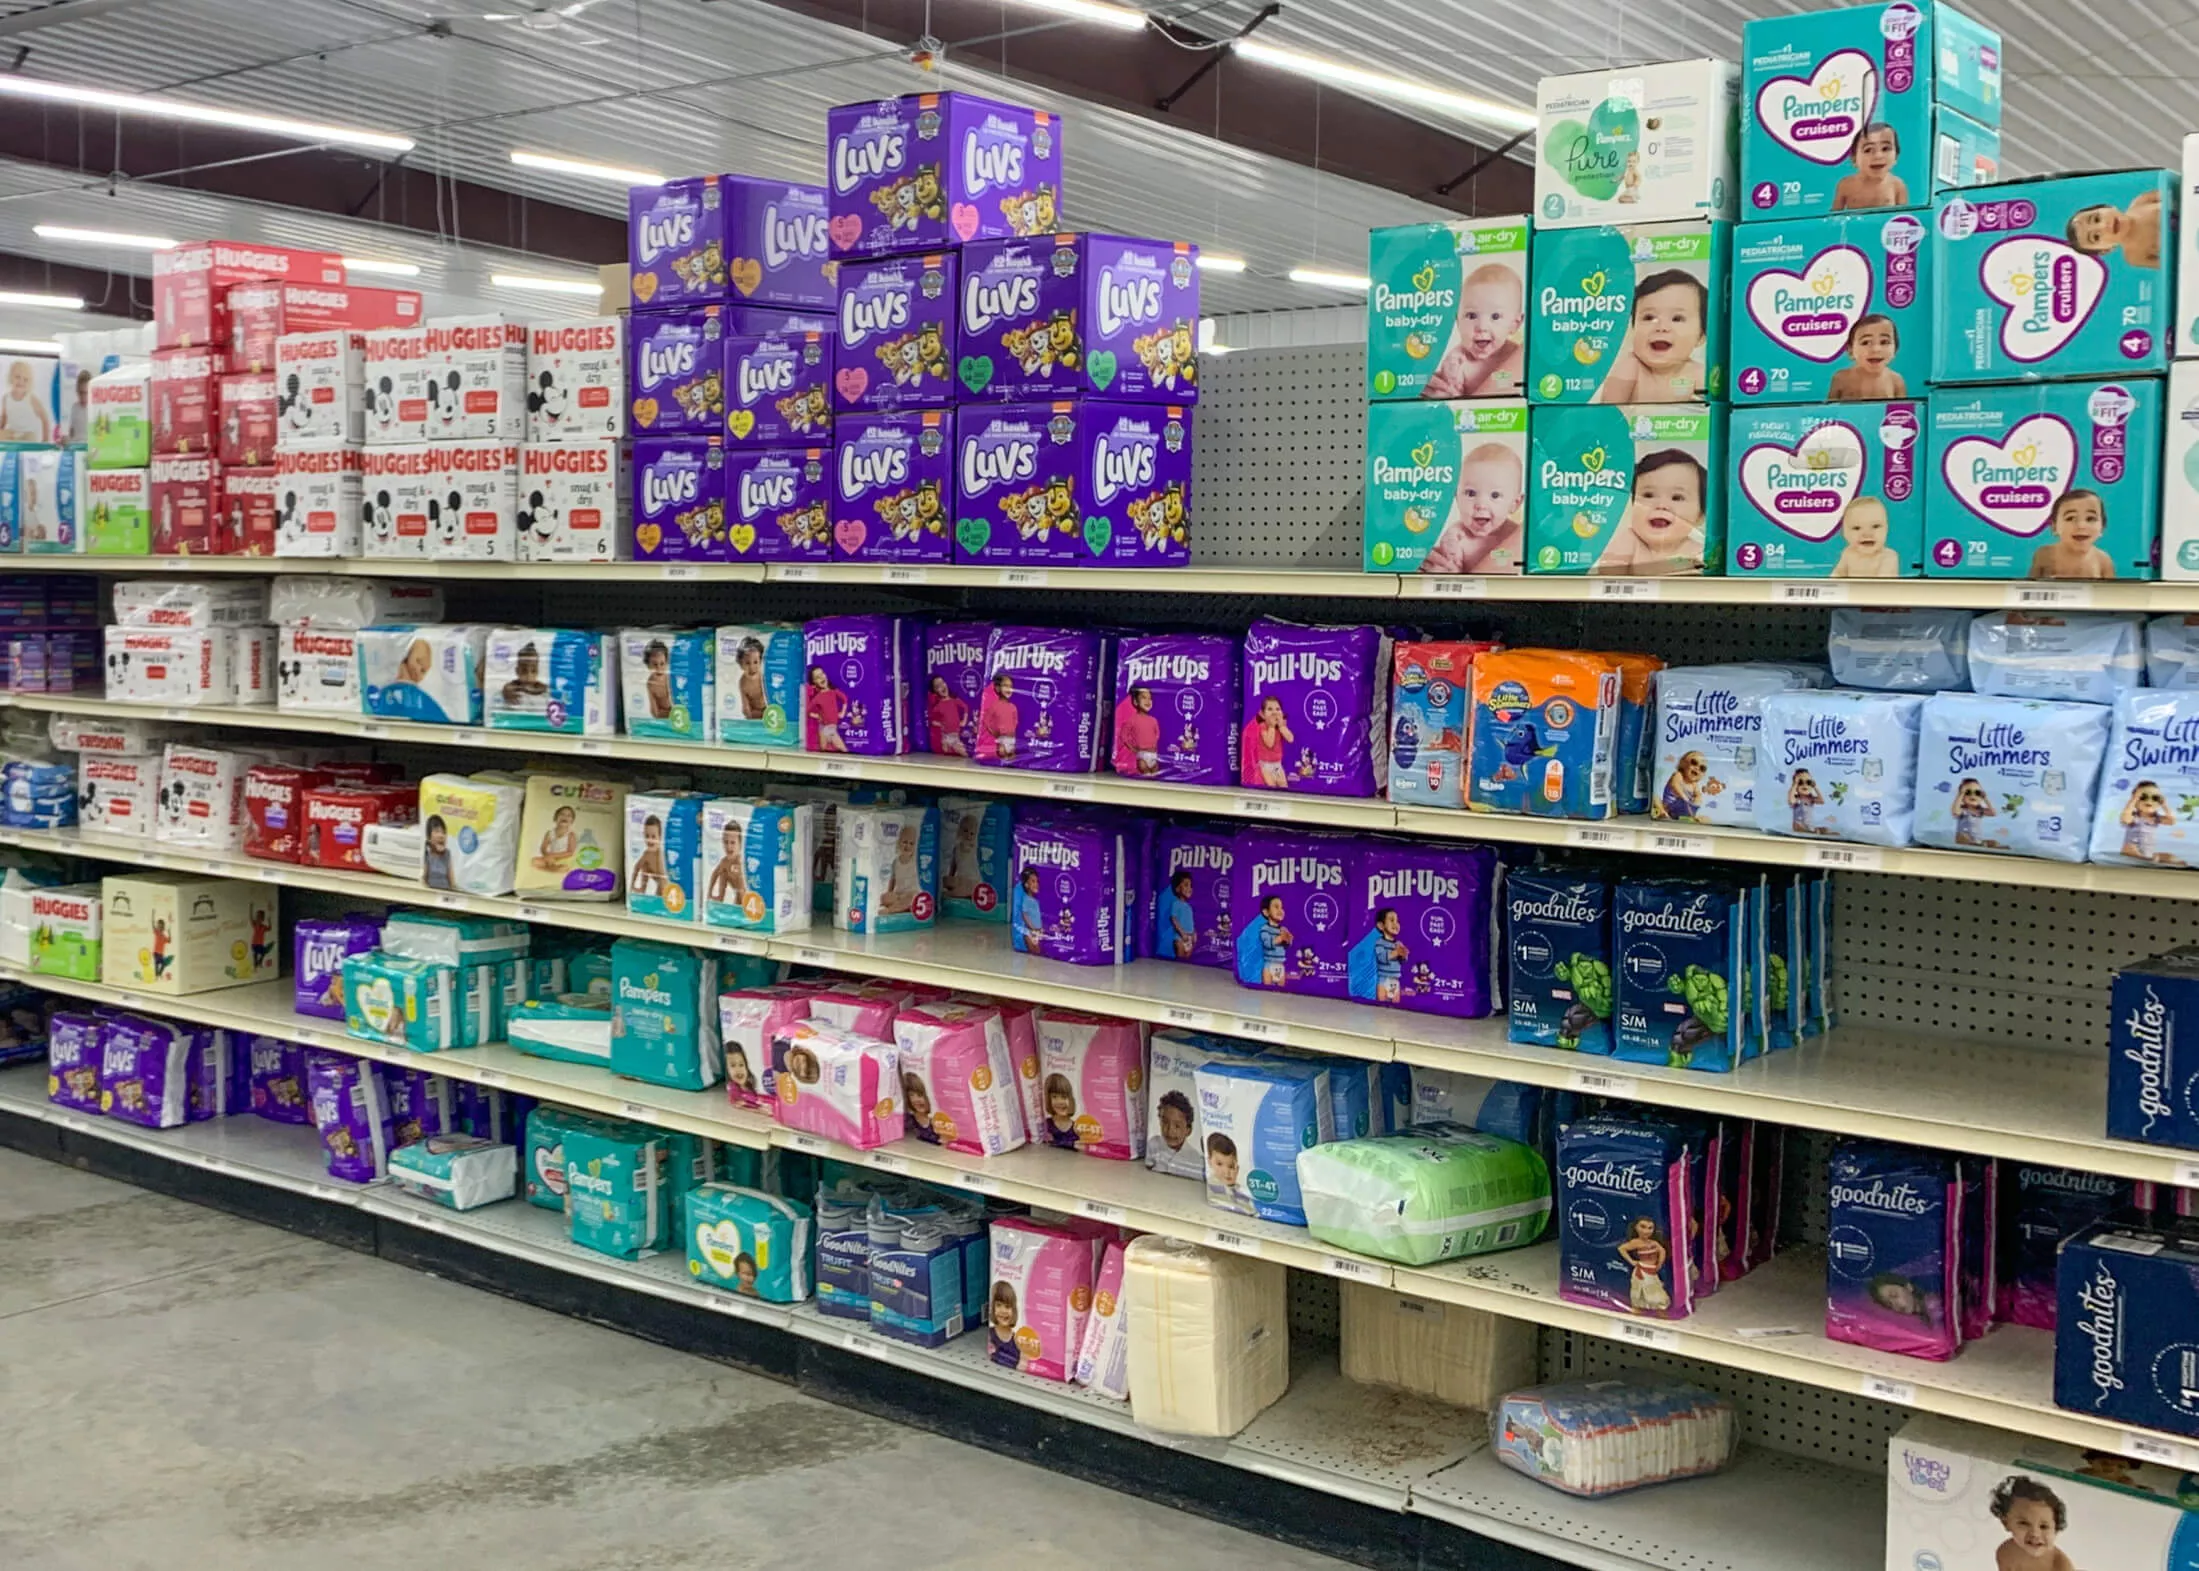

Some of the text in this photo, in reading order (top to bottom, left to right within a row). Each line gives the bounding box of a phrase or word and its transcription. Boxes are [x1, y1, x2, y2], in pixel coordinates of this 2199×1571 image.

[1753, 51, 1811, 66] PEDIATRICIAN
[1784, 95, 1860, 120] Pampers
[1796, 122, 1849, 137] cruisers
[836, 134, 902, 192] Luvs
[965, 132, 1022, 194] Luvs
[1567, 135, 1619, 172] Pure
[1760, 185, 1772, 199] 4
[1783, 182, 1800, 193] 70
[1550, 197, 1558, 211] 2
[640, 214, 693, 263] Luvs
[765, 207, 828, 267] Luvs
[1477, 227, 1518, 244] air-dry
[1656, 237, 1700, 253] air-dry
[1893, 236, 1909, 246] FIT
[216, 248, 288, 271] HUGGIES
[1741, 245, 1803, 256] PEDIATRICIAN
[285, 288, 348, 307] HUGGIES
[1376, 284, 1454, 313] Pampers
[2023, 252, 2050, 333] Pampers
[2061, 261, 2072, 316] cruisers
[966, 276, 1037, 332] Luvs
[1099, 271, 1159, 335] Luvs
[1541, 288, 1626, 317] Pampers
[1775, 289, 1854, 314] Pampers
[843, 291, 906, 347] Luvs
[1386, 314, 1443, 328] baby-dry
[1552, 319, 1614, 333] baby-dry
[1788, 319, 1842, 331] cruisers
[2123, 306, 2136, 325] 70
[426, 326, 502, 351] HUGGIES
[534, 327, 615, 353] HUGGIES
[1976, 309, 1985, 370] PEDIATRICIAN
[2124, 337, 2138, 352] 4
[279, 340, 337, 361] HUGGIES
[640, 342, 693, 388] Luvs
[1771, 369, 1788, 380] 70
[740, 358, 793, 403] Luvs
[1381, 374, 1414, 388] 1 120
[1546, 377, 1581, 392] 2 112
[1746, 371, 1759, 384] 4
[91, 384, 142, 404] HUGGIES
[1477, 410, 1519, 424] air-dry
[1937, 412, 2003, 421] PEDIATRICIAN
[2100, 407, 2117, 417] FIT
[488, 419, 495, 434] 5
[607, 417, 614, 431] 6
[1655, 418, 1699, 433] air-dry
[152, 460, 210, 481] HUGGIES
[274, 452, 339, 472] HUGGIES
[363, 453, 430, 475] HUGGIES
[429, 449, 500, 471] HUGGIES
[525, 450, 607, 473] HUGGIES
[964, 440, 1034, 494] Luvs
[1096, 438, 1153, 501] Luvs
[842, 445, 906, 498] Luvs
[1374, 457, 1452, 486] Pampers
[1542, 461, 1626, 490] Pampers
[1768, 464, 1847, 490] Pampers
[1972, 458, 2058, 485] Pampers
[89, 474, 141, 492] HUGGIES
[643, 468, 697, 514] Luvs
[741, 473, 794, 517] Luvs
[1384, 488, 1441, 502] baby-dry
[1552, 492, 1614, 506] baby-dry
[1781, 497, 1835, 508] cruisers
[1986, 492, 2044, 503] cruisers
[417, 538, 424, 551] 4
[487, 541, 494, 554] 5
[597, 538, 605, 553] 6
[1380, 544, 1412, 559] 1 120
[1744, 546, 1756, 561] 3
[1766, 544, 1785, 555] 84
[1940, 543, 1955, 558] 4
[1968, 542, 1987, 553] 70
[1544, 549, 1578, 564] 2 112
[294, 633, 353, 656] HUGGIES
[201, 640, 211, 688] HUGGIES
[1127, 656, 1209, 692] Pull-Ups
[1254, 652, 1341, 696] Pull-Ups
[1694, 690, 1739, 714] Little
[674, 710, 683, 727] 3
[767, 710, 777, 728] 3
[1666, 714, 1762, 743] Swimmers
[1808, 715, 1846, 739] Little
[1978, 722, 2024, 748] Little
[1784, 739, 1868, 765] Swimmers
[1950, 746, 2050, 774] Swimmers
[169, 755, 218, 776] HUGGIES
[247, 776, 292, 803] HUGGIES
[550, 782, 614, 801] cuties
[1744, 790, 1754, 801] 4
[310, 801, 362, 822] HUGGIES
[1869, 802, 1881, 816] 3
[2050, 817, 2062, 831] 3
[1169, 846, 1233, 876] Pull-Up
[1252, 858, 1342, 897] Pull-Ups
[668, 890, 677, 905] 4
[978, 889, 989, 906] 5
[1368, 870, 1459, 909] Pull-Ups
[32, 896, 89, 920] HUGGIES
[747, 900, 757, 914] 4
[916, 898, 927, 915] 5
[1512, 893, 1599, 923] goodnites
[1623, 899, 1717, 934] goodnites
[304, 941, 345, 982] Luvs
[1319, 962, 1347, 971] 2T-3T
[619, 977, 671, 1006] Pampers
[1434, 979, 1464, 989] 2T-3T
[1513, 1000, 1537, 1014] S/M
[1621, 1014, 1647, 1029] S/M
[51, 1035, 80, 1067] Luvs
[103, 1044, 135, 1075] Luvs
[252, 1043, 281, 1076] Luvs
[2125, 991, 2171, 1127] goodnites
[568, 1161, 612, 1196] Pampers
[1249, 1178, 1277, 1192] 3T-4T
[1566, 1162, 1654, 1194] goodnites
[2019, 1167, 2116, 1195] goodnites
[1830, 1180, 1929, 1215] goodnites
[872, 1256, 917, 1277] GoodNites
[1570, 1266, 1595, 1280] S/M
[2077, 1267, 2124, 1398] goodnites
[1903, 1450, 1950, 1478] tippy
[1909, 1471, 1947, 1493] toes
